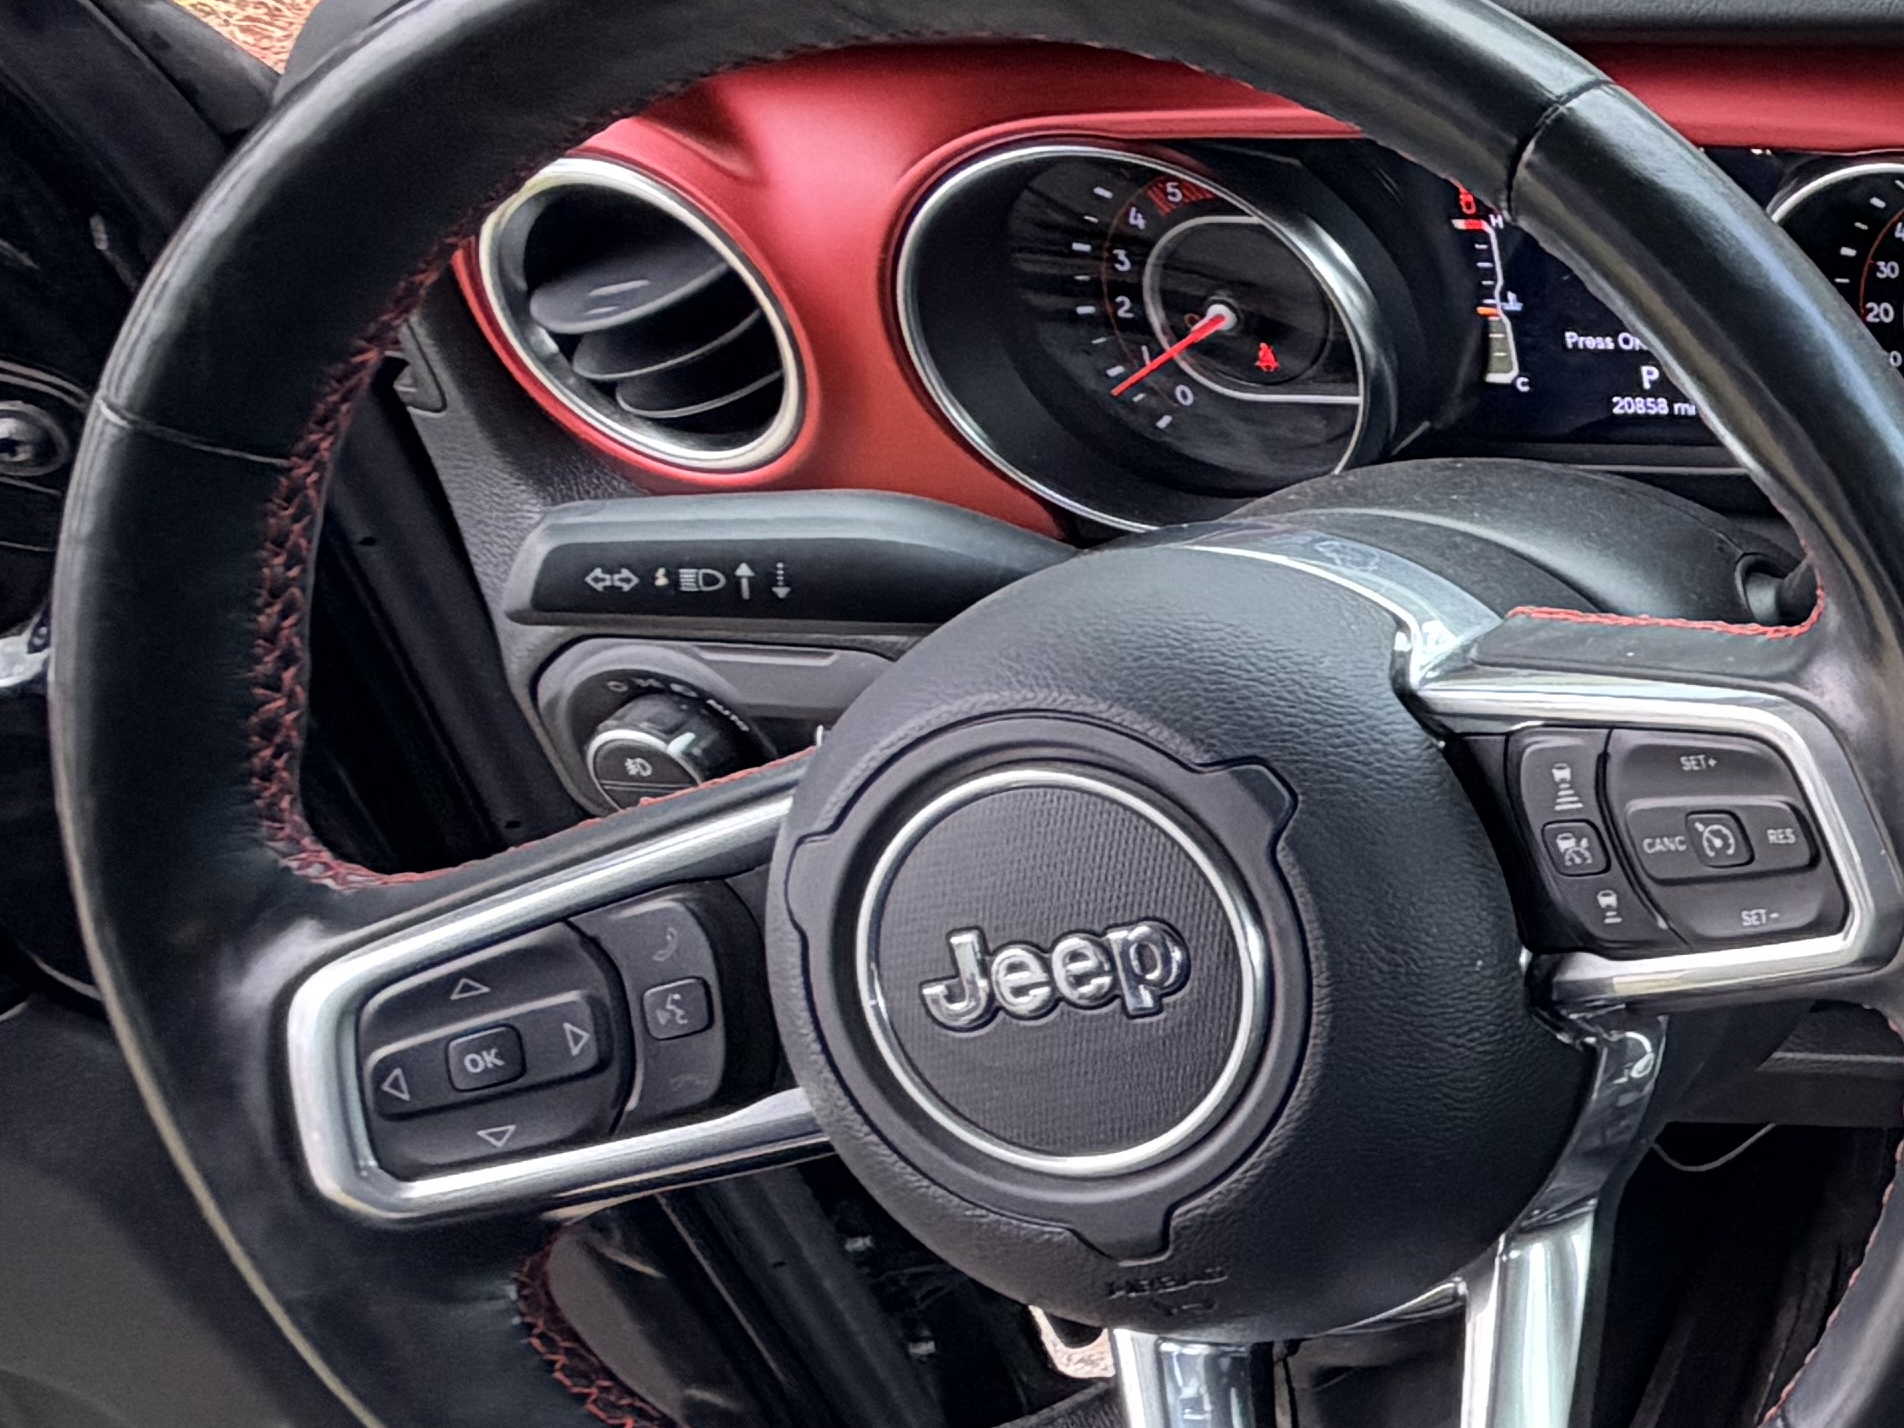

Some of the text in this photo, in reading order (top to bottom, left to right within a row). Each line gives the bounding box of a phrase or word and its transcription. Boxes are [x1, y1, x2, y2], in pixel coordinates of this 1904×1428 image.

[1166, 182, 1184, 203] 5
[1128, 207, 1146, 230] 4
[1113, 249, 1132, 272] 3
[1876, 260, 1900, 280] 30
[1114, 295, 1135, 319] 2
[1865, 301, 1895, 324] 20
[1565, 332, 1614, 350] Press
[1515, 376, 1531, 393] C
[1640, 365, 1660, 390] P
[1174, 384, 1195, 406] 0
[1611, 396, 1669, 416] 20858
[1642, 838, 1687, 855] CANC
[1766, 828, 1797, 846] RES
[921, 917, 1190, 1031] Jeep
[464, 1046, 505, 1074] OK
